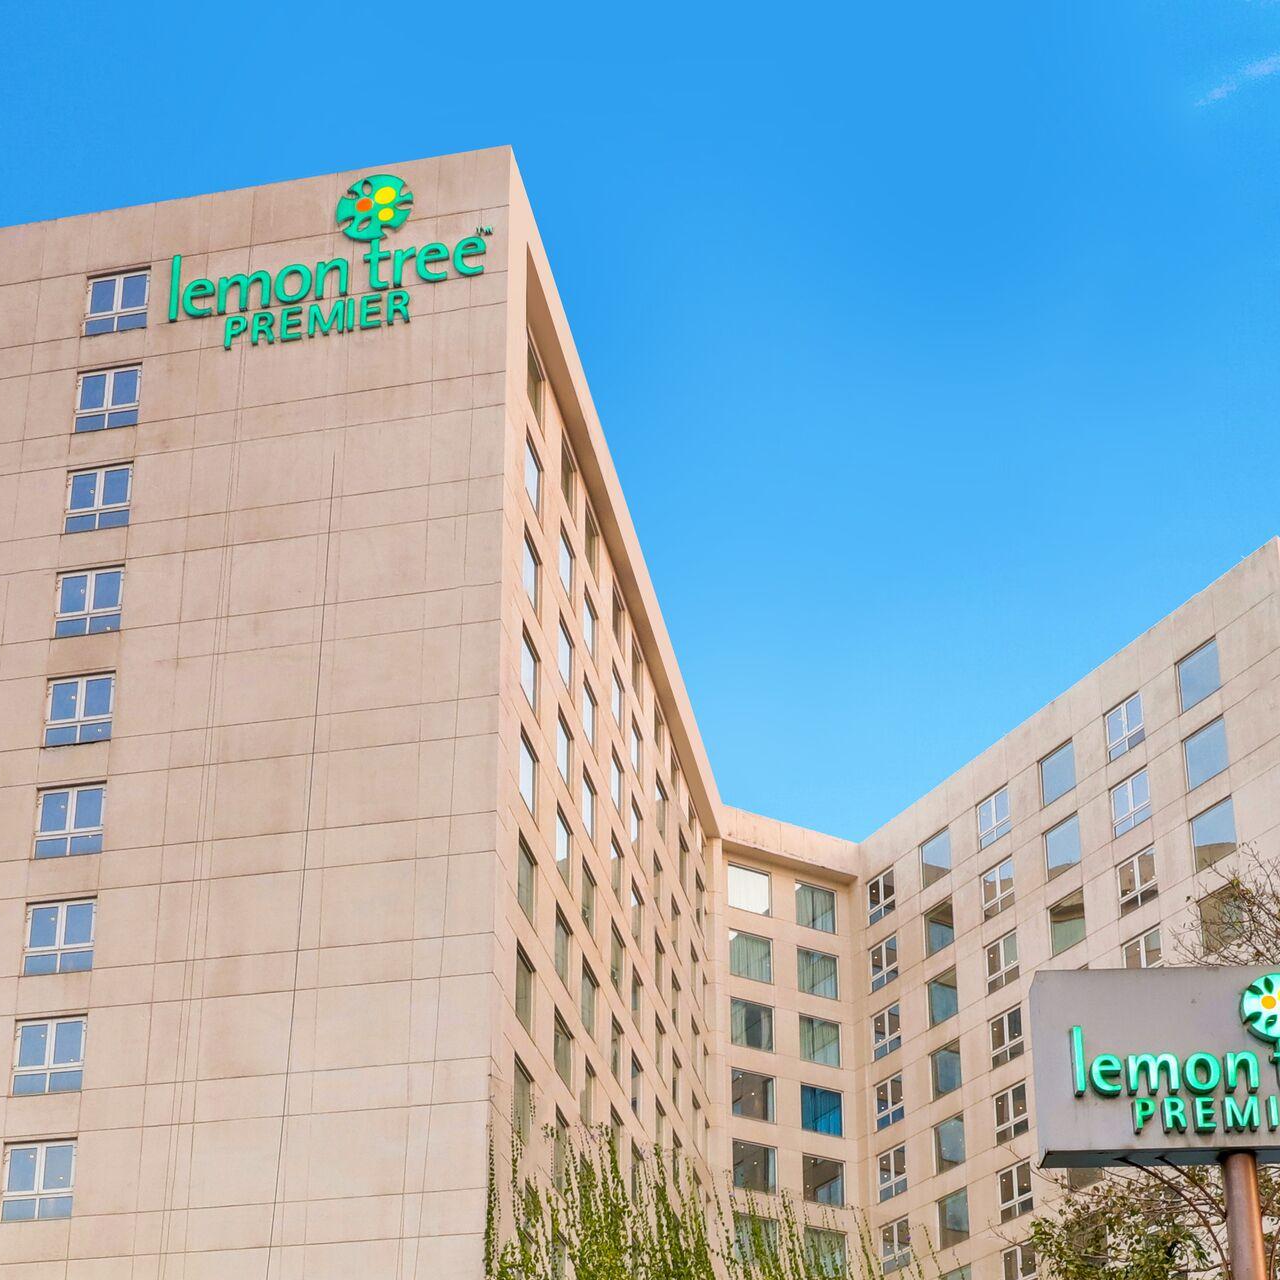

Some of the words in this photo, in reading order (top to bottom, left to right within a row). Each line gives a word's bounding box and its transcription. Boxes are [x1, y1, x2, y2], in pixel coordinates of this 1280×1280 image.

[168, 254, 349, 322] lemon
[363, 235, 487, 290] tree
[224, 290, 411, 351] PREMIER
[1070, 1025, 1260, 1098] lemon
